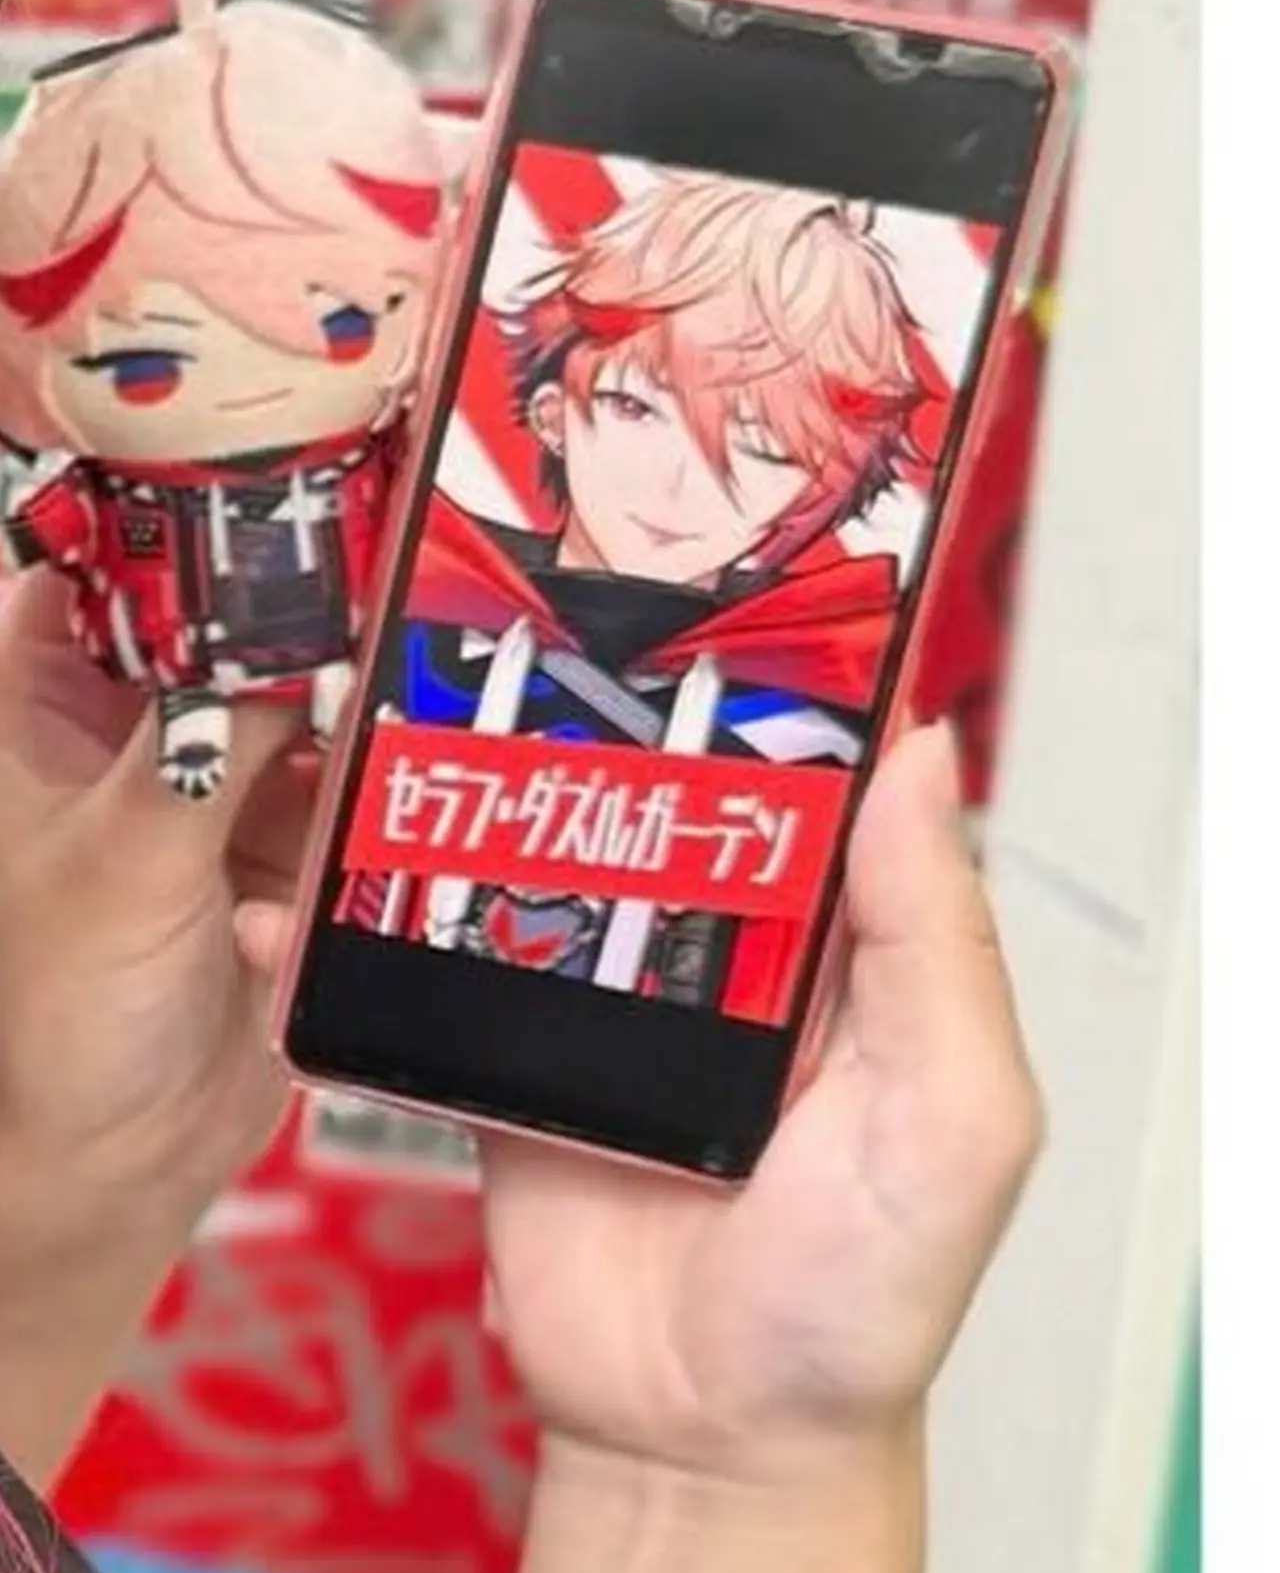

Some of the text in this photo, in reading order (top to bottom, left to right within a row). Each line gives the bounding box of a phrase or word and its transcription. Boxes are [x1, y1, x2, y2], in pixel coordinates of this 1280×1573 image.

[384, 754, 802, 886] セラフ・ダズルガーデン
